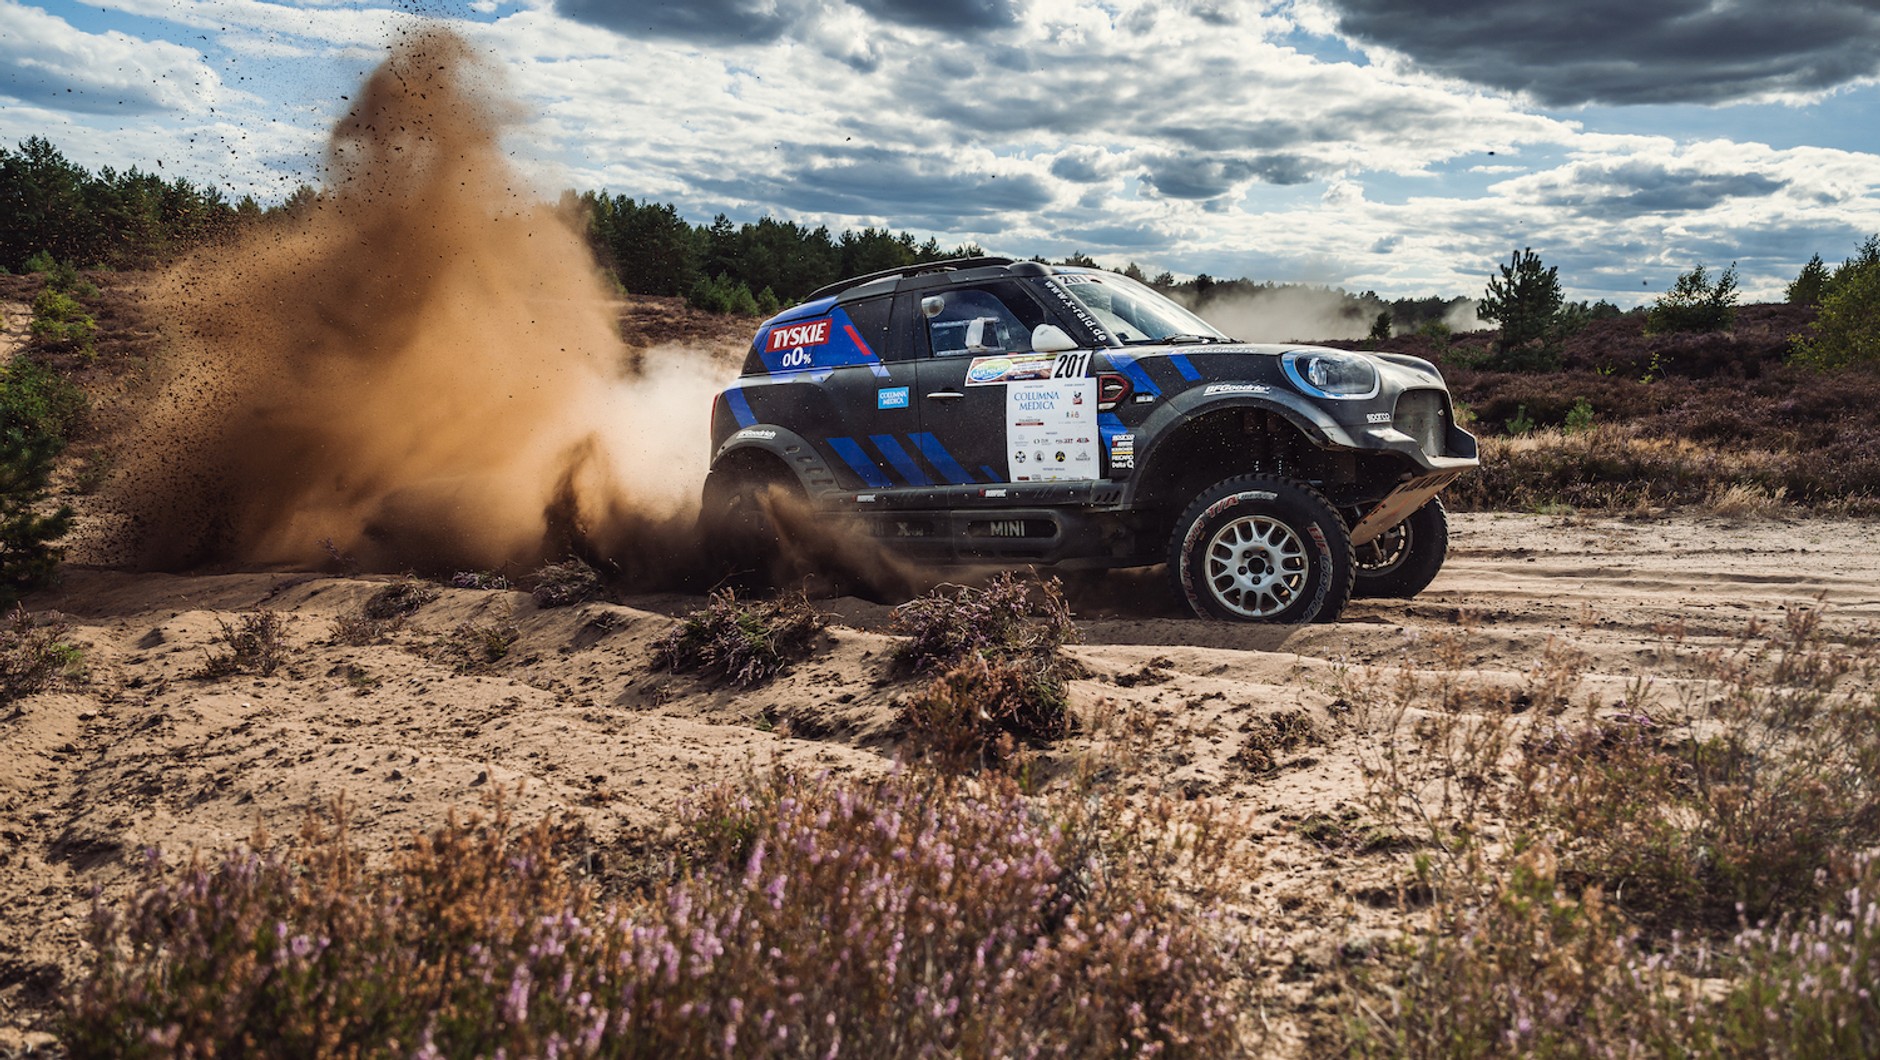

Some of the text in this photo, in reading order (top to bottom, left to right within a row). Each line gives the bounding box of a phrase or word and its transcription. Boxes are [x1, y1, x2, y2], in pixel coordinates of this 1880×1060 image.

[1045, 280, 1107, 341] www.x-raid.de
[773, 322, 827, 349] TYSKIE
[1054, 353, 1088, 379] 201
[880, 391, 907, 400] COLUMNA
[882, 398, 904, 406] MEDICA
[1013, 390, 1060, 402] COLUMNA
[1018, 400, 1055, 411] MEDICA
[989, 519, 1026, 537] MINI
